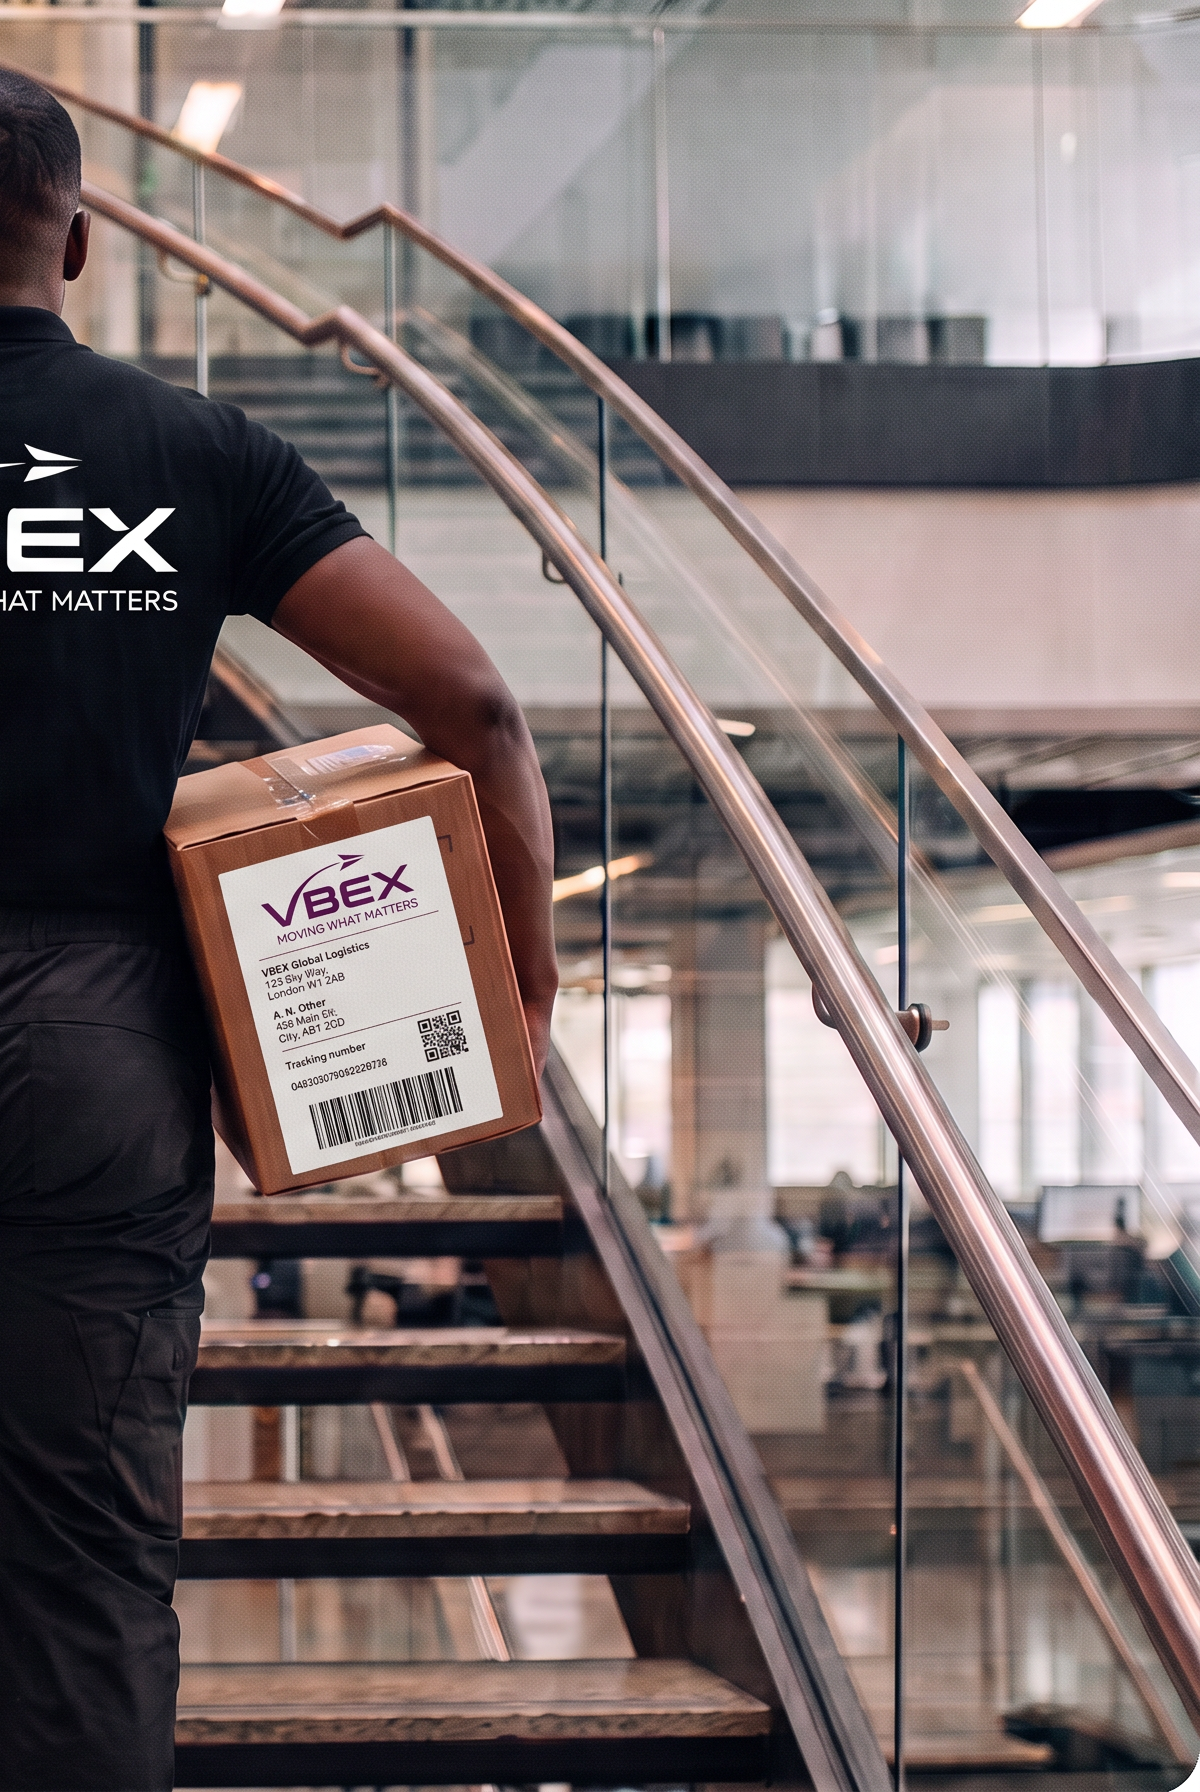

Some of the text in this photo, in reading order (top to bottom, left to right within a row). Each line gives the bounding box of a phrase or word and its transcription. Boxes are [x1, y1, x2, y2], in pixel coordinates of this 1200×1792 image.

[52, 589, 178, 612] MATTERS
[261, 862, 414, 927] VBEX
[277, 898, 419, 945] MOVING WHAT MATTERS
[261, 942, 370, 978] VBEX Global Logistics
[267, 972, 345, 1001] London W1 2AB
[273, 999, 326, 1020] A. N. Other
[296, 1013, 320, 1027] Main
[302, 1023, 322, 1037] AB1
[285, 1043, 366, 1071] Tracking number
